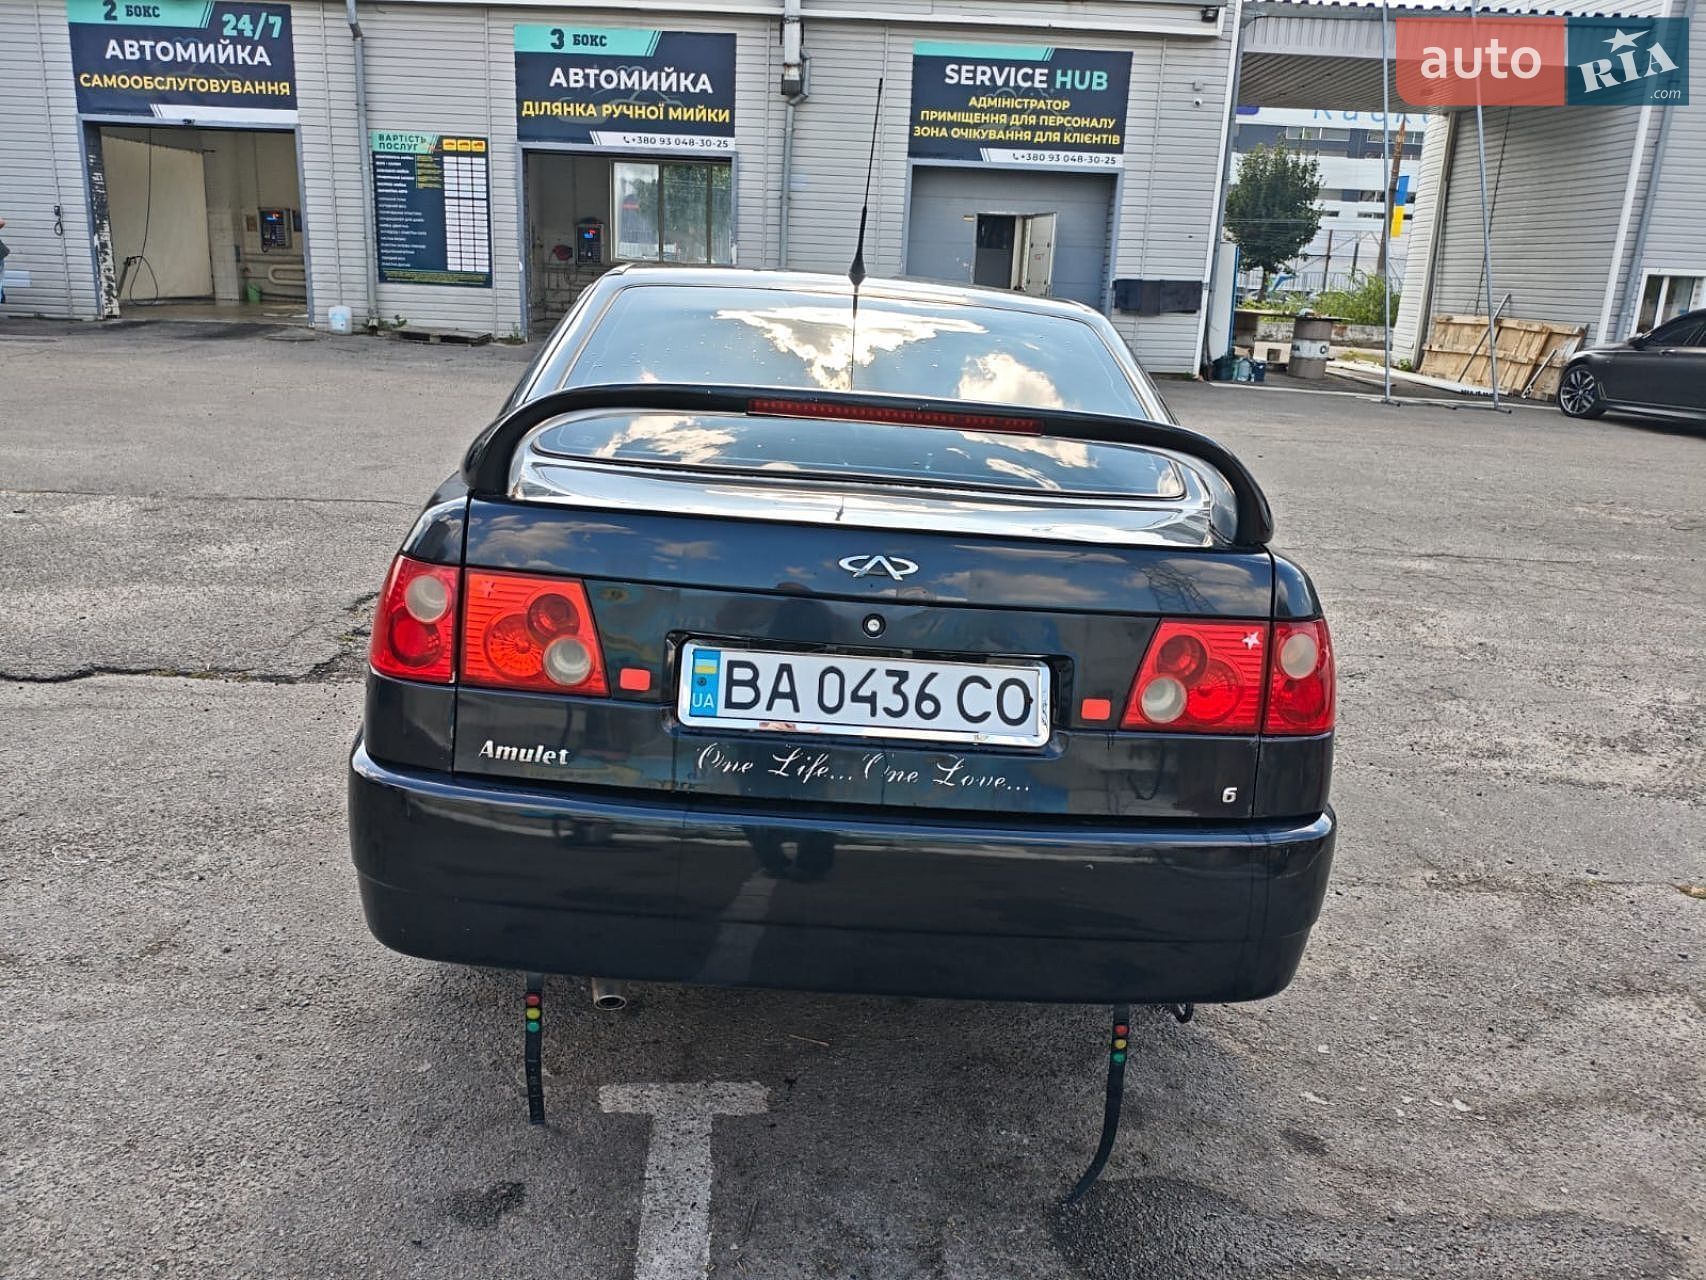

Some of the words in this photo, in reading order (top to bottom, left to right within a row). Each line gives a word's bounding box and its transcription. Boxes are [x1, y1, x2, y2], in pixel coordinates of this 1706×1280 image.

[103, 0, 118, 21] 2
[125, 5, 161, 18] БОКС
[222, 12, 283, 41] 24/7
[550, 28, 565, 50] 3
[572, 33, 608, 48] БОКС
[105, 39, 272, 67] АВТОМИЙКА
[80, 73, 291, 96] САМООБСЛУГОВУВАННЯ
[549, 66, 714, 94] АВТОМИЙКА
[944, 63, 1049, 88] SERVICE
[1055, 69, 1109, 92] HUB
[521, 100, 597, 118] ДІЛЯНКА
[602, 101, 665, 121] РУЧНОЇ
[668, 104, 731, 124] МИЙКИ
[968, 95, 1071, 111] АДМІНІСТРАТОР
[920, 110, 1008, 125] ПРИМІЩЕННЯ
[1009, 113, 1037, 127] ДЛЯ
[1039, 114, 1116, 129] ПЕРСОНАЛУ
[631, 135, 657, 146] +380
[659, 136, 672, 146] 93
[674, 137, 729, 149] 048-30-25
[913, 126, 949, 139] ЗОНА
[950, 126, 1032, 142] ОЧІКУВАННЯ
[1033, 130, 1061, 144] ДЛЯ
[1063, 131, 1121, 146] КЛІЄНТІВ
[1020, 152, 1046, 163] +380
[1048, 153, 1061, 163] 93
[1062, 153, 1117, 165] 048-30-25
[691, 692, 715, 710] UA
[724, 659, 801, 714] BA
[816, 665, 942, 722] 0436
[956, 674, 1034, 727] CO
[478, 740, 570, 767] Amulet
[697, 741, 754, 775] One
[1221, 786, 1238, 804] 6
